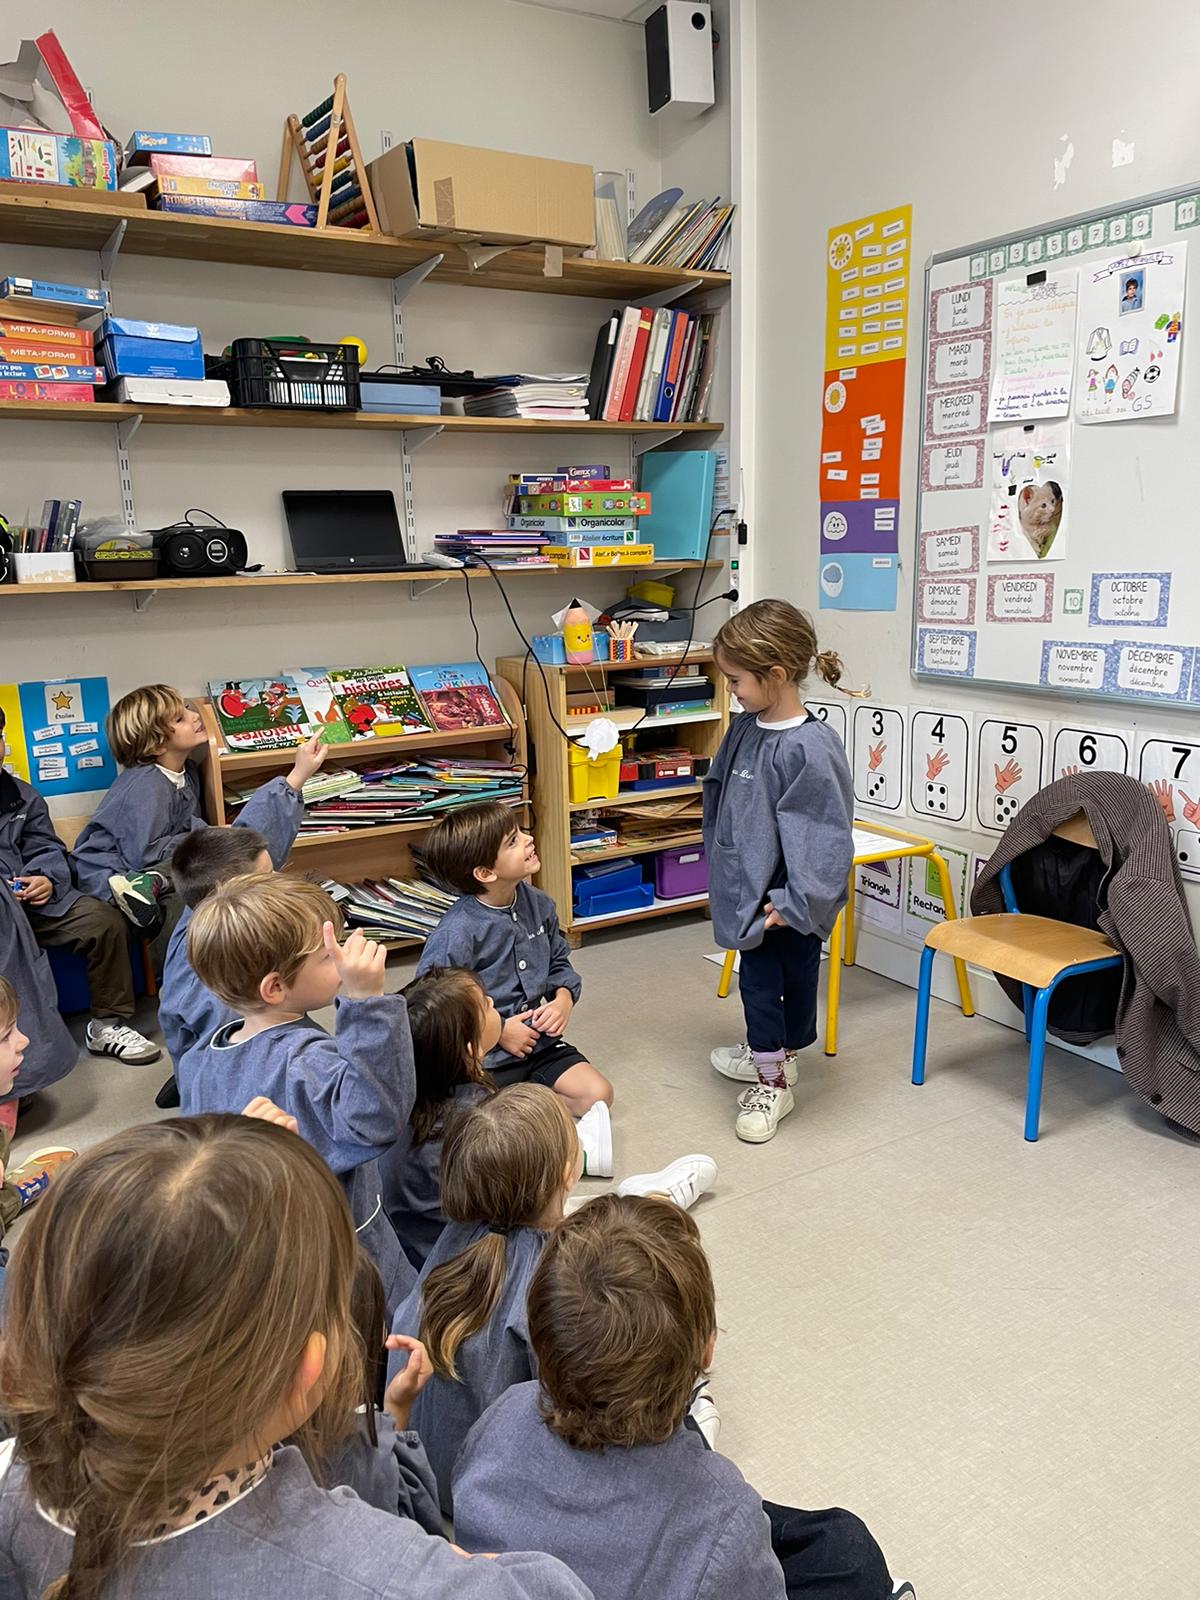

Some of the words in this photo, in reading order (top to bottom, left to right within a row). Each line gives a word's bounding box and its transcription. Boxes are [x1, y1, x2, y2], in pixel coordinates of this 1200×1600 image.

[1181, 207, 1193, 219] 11
[1114, 225, 1121, 236] 8
[1137, 220, 1145, 232] 9
[1072, 235, 1079, 246] 6
[1093, 229, 1100, 240] 7
[1031, 246, 1038, 256] 4
[1051, 240, 1058, 250] 5
[1013, 248, 1020, 259] 3
[976, 263, 981, 273] 1
[994, 257, 1000, 267] 2
[951, 292, 971, 304] LUNDI
[10, 325, 76, 338] META-FORMS
[10, 348, 76, 360] META-FORMS
[949, 343, 971, 356] MARDI
[940, 394, 974, 408] MERCREDI
[1132, 394, 1152, 412] GS
[944, 448, 962, 458] JEUDI
[581, 518, 625, 528] Organicolor
[936, 535, 961, 547] SAMEDI
[928, 585, 961, 596] DIMANCHE
[1002, 582, 1037, 593] VENDREDI
[1110, 581, 1148, 593] OCTOBRE
[1069, 597, 1079, 607] 10
[1112, 595, 1144, 605] octobre
[928, 634, 965, 646] SEPTEMBRE
[1056, 649, 1098, 662] NOVEMBRE
[1057, 663, 1093, 673] novembre
[341, 678, 404, 694] histoires
[872, 711, 884, 736] 3
[233, 724, 303, 742] histoires
[931, 717, 945, 743] 4
[1001, 726, 1017, 754] 5
[1079, 735, 1097, 765] 6
[1172, 747, 1192, 778] 7
[861, 875, 891, 895] Triangle
